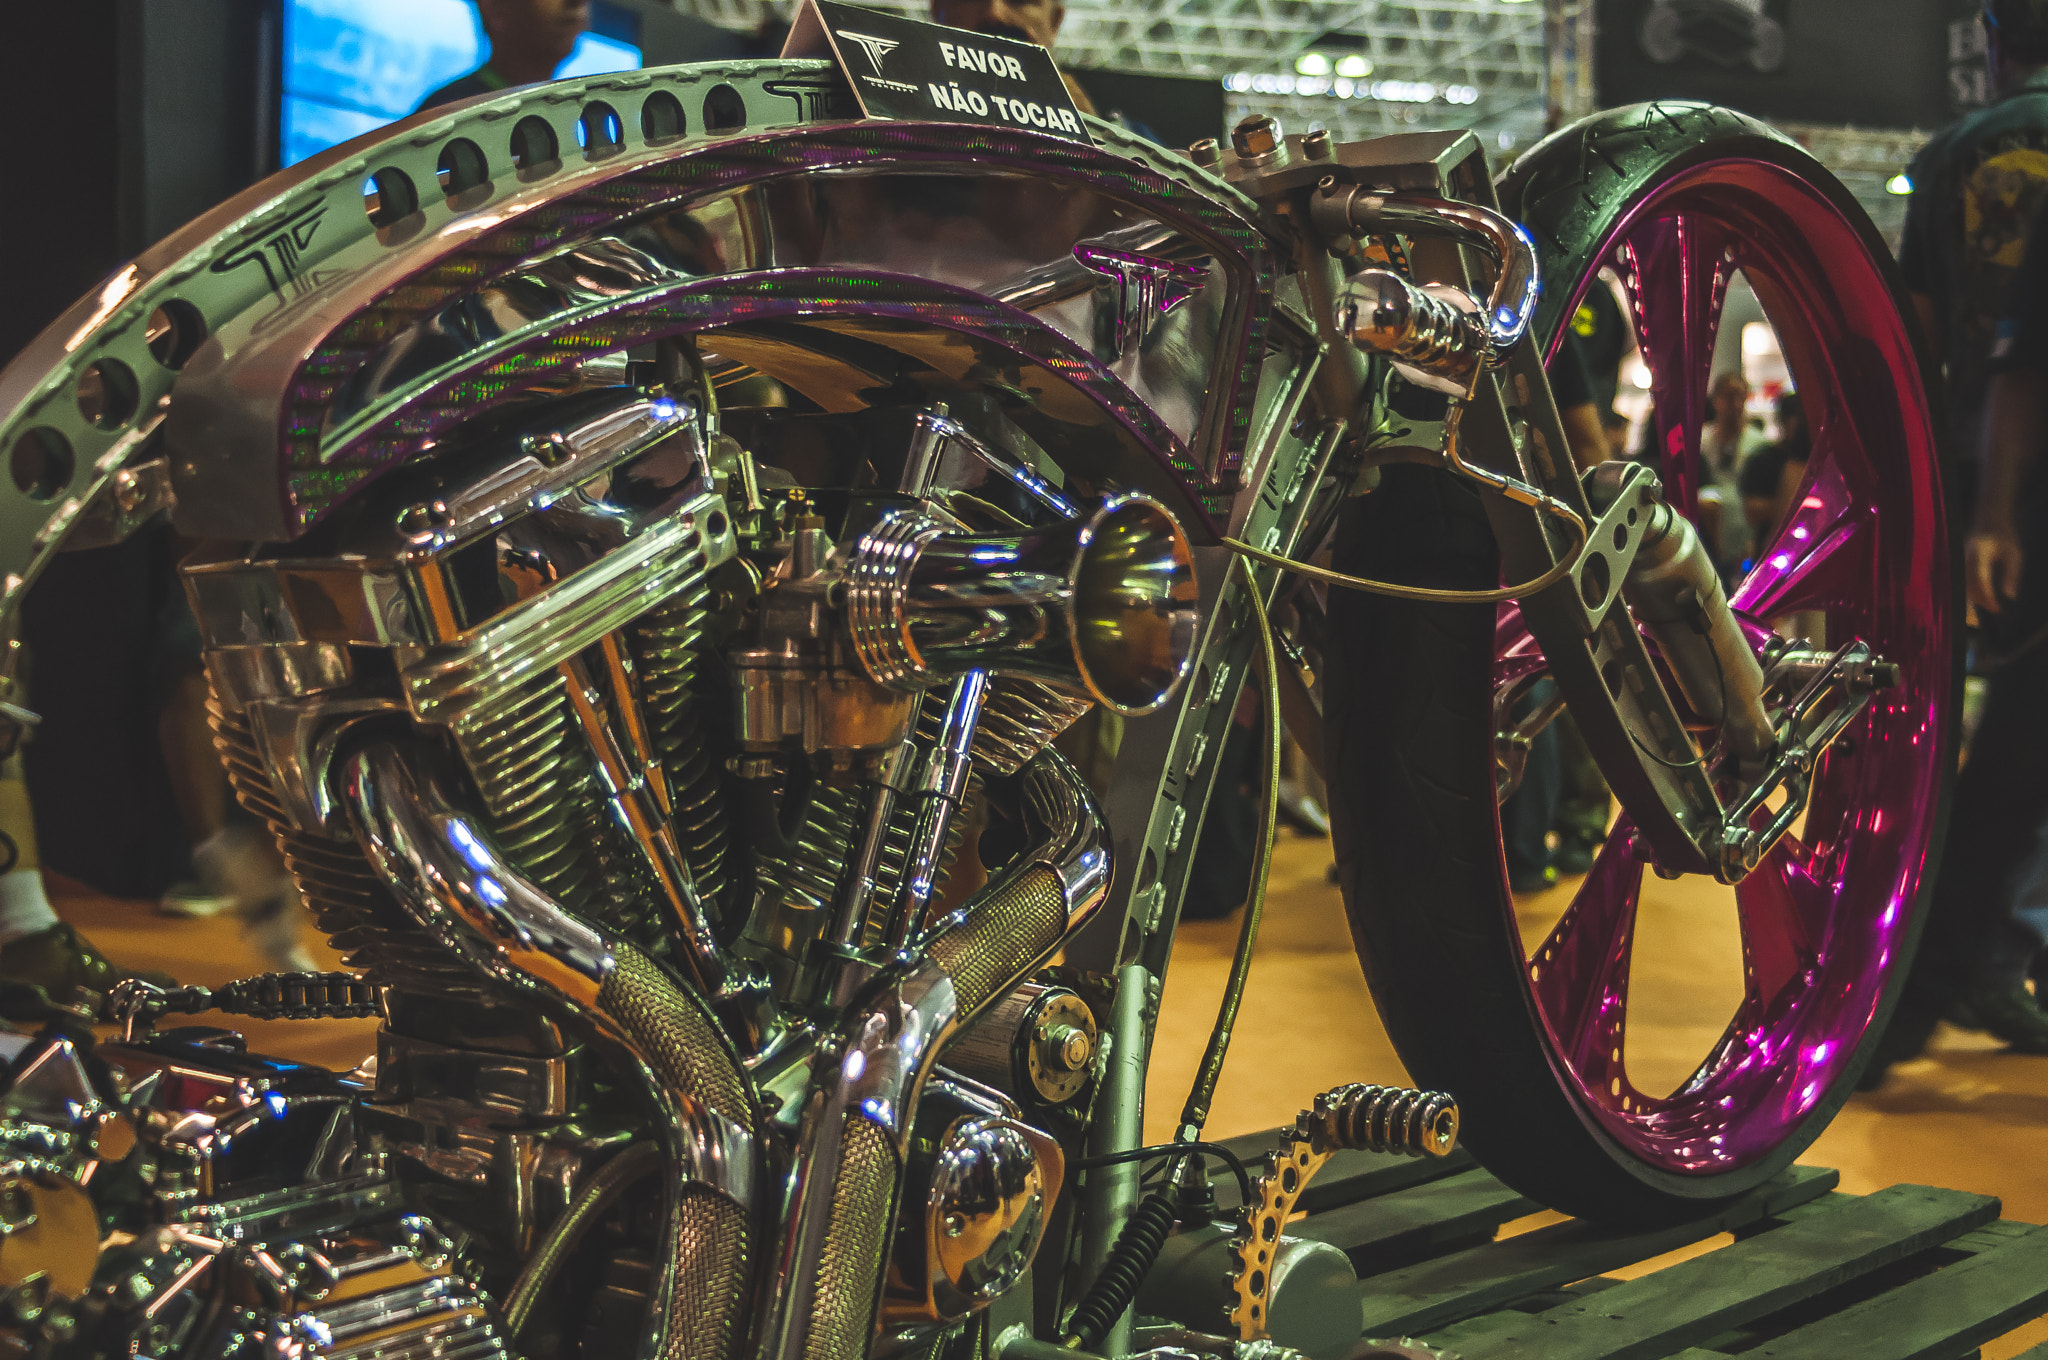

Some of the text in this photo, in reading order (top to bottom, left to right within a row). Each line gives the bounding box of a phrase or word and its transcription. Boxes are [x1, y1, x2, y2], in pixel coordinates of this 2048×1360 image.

[938, 41, 1027, 82] FAVOR
[928, 81, 988, 117] NÃO
[990, 95, 1081, 134] TOCAR
